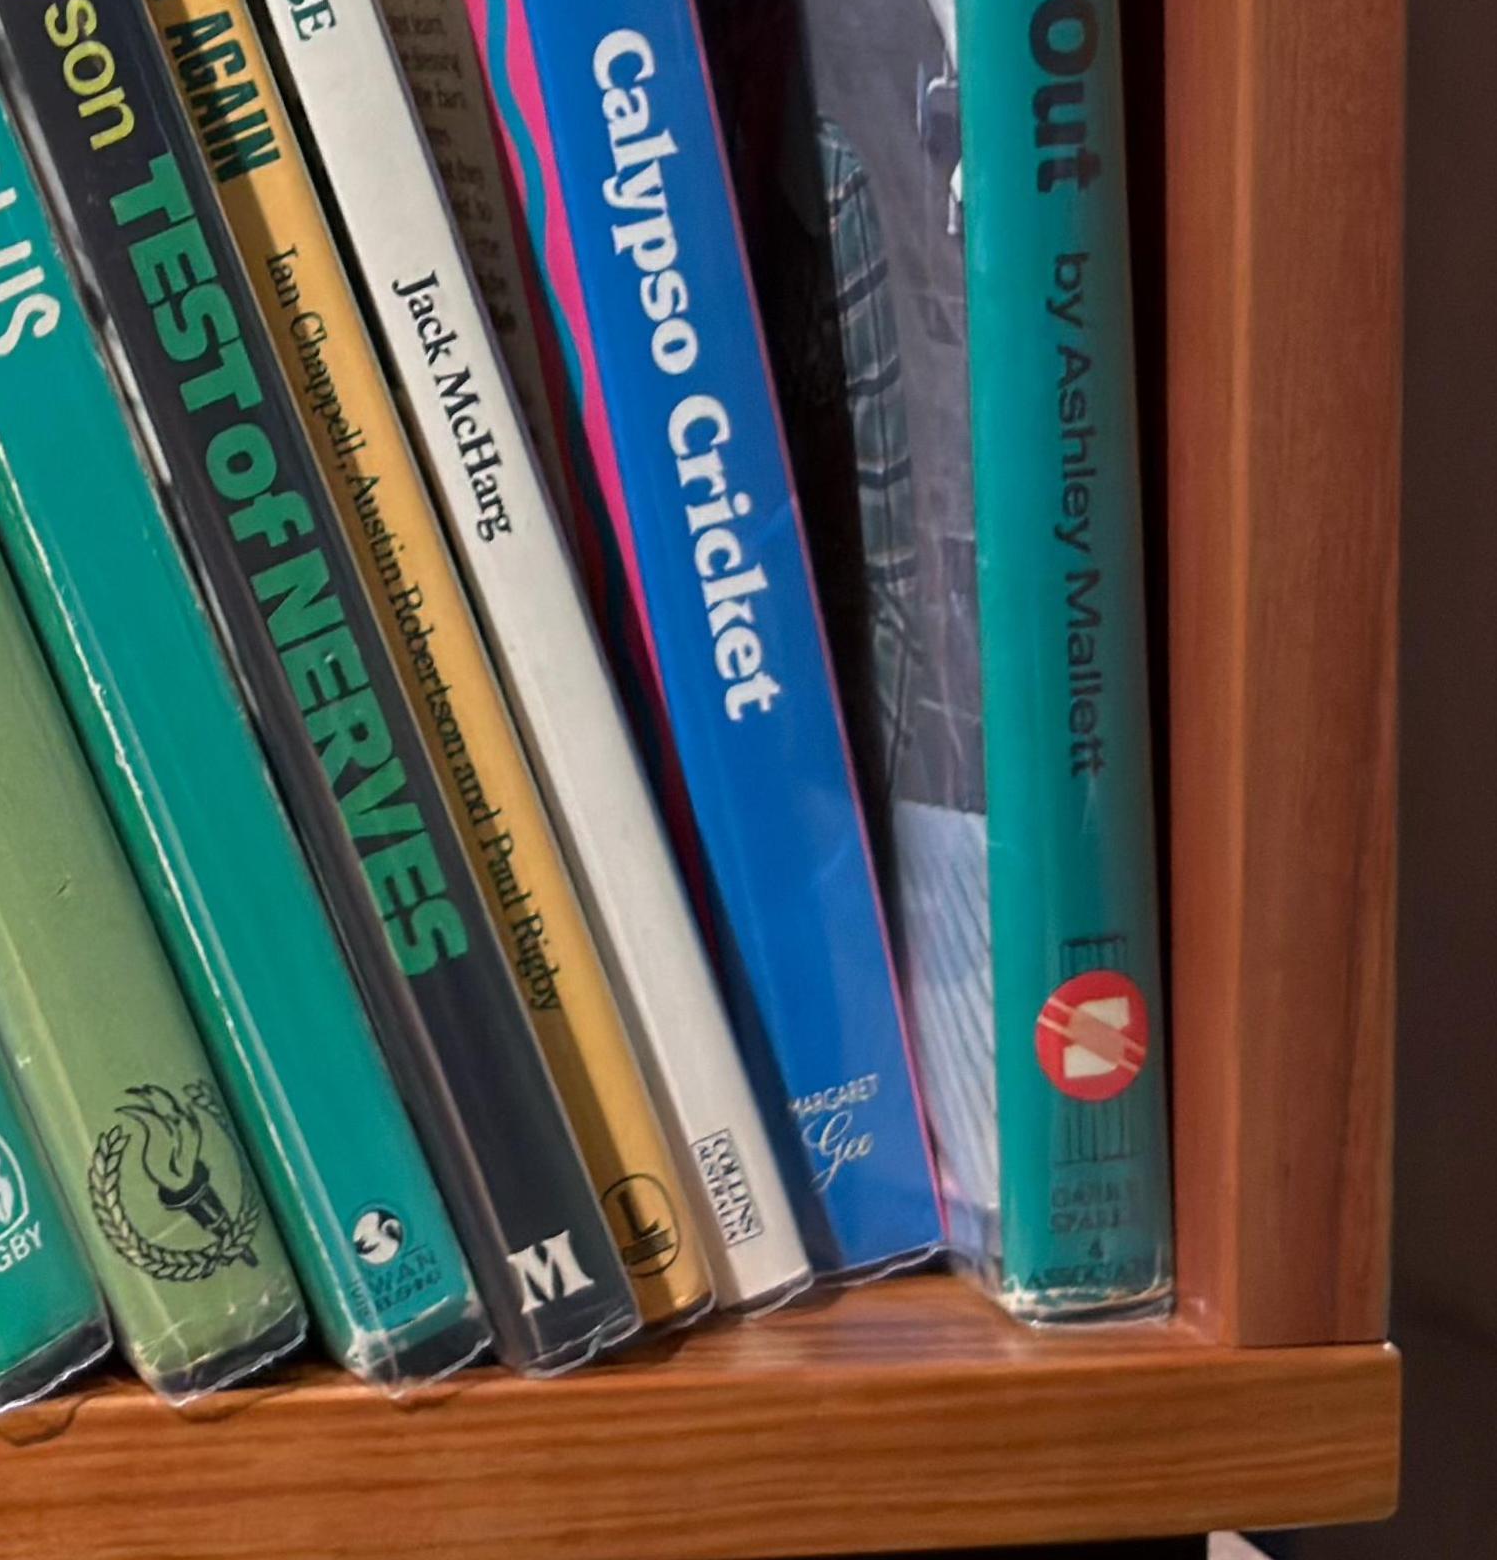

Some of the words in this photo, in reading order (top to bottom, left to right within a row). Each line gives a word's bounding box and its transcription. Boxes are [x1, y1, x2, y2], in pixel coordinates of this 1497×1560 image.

[166, 9, 280, 184] AGAIN
[110, 152, 263, 415] TEST
[1046, 251, 1091, 329] by
[393, 271, 451, 368] Jack
[434, 368, 513, 542] McHarg
[594, 29, 698, 376] Calypso
[668, 393, 787, 721] Cricket
[1055, 345, 1099, 554] Ashley
[207, 422, 315, 550] of
[267, 243, 298, 315] Ian
[288, 309, 365, 468] Chappell,
[347, 471, 400, 585] Austin
[393, 582, 460, 760] Robertson
[453, 761, 501, 829] and
[482, 829, 532, 907] Paul
[512, 907, 559, 1011] Rigby
[1065, 572, 1109, 778] Mallett
[251, 548, 467, 979] NERVES
[788, 1073, 877, 1120] MARGARET
[801, 1109, 873, 1192] Gee
[508, 1231, 593, 1315] M
[699, 1146, 738, 1241] AUSTRALIA
[712, 1138, 753, 1234] COLLINS
